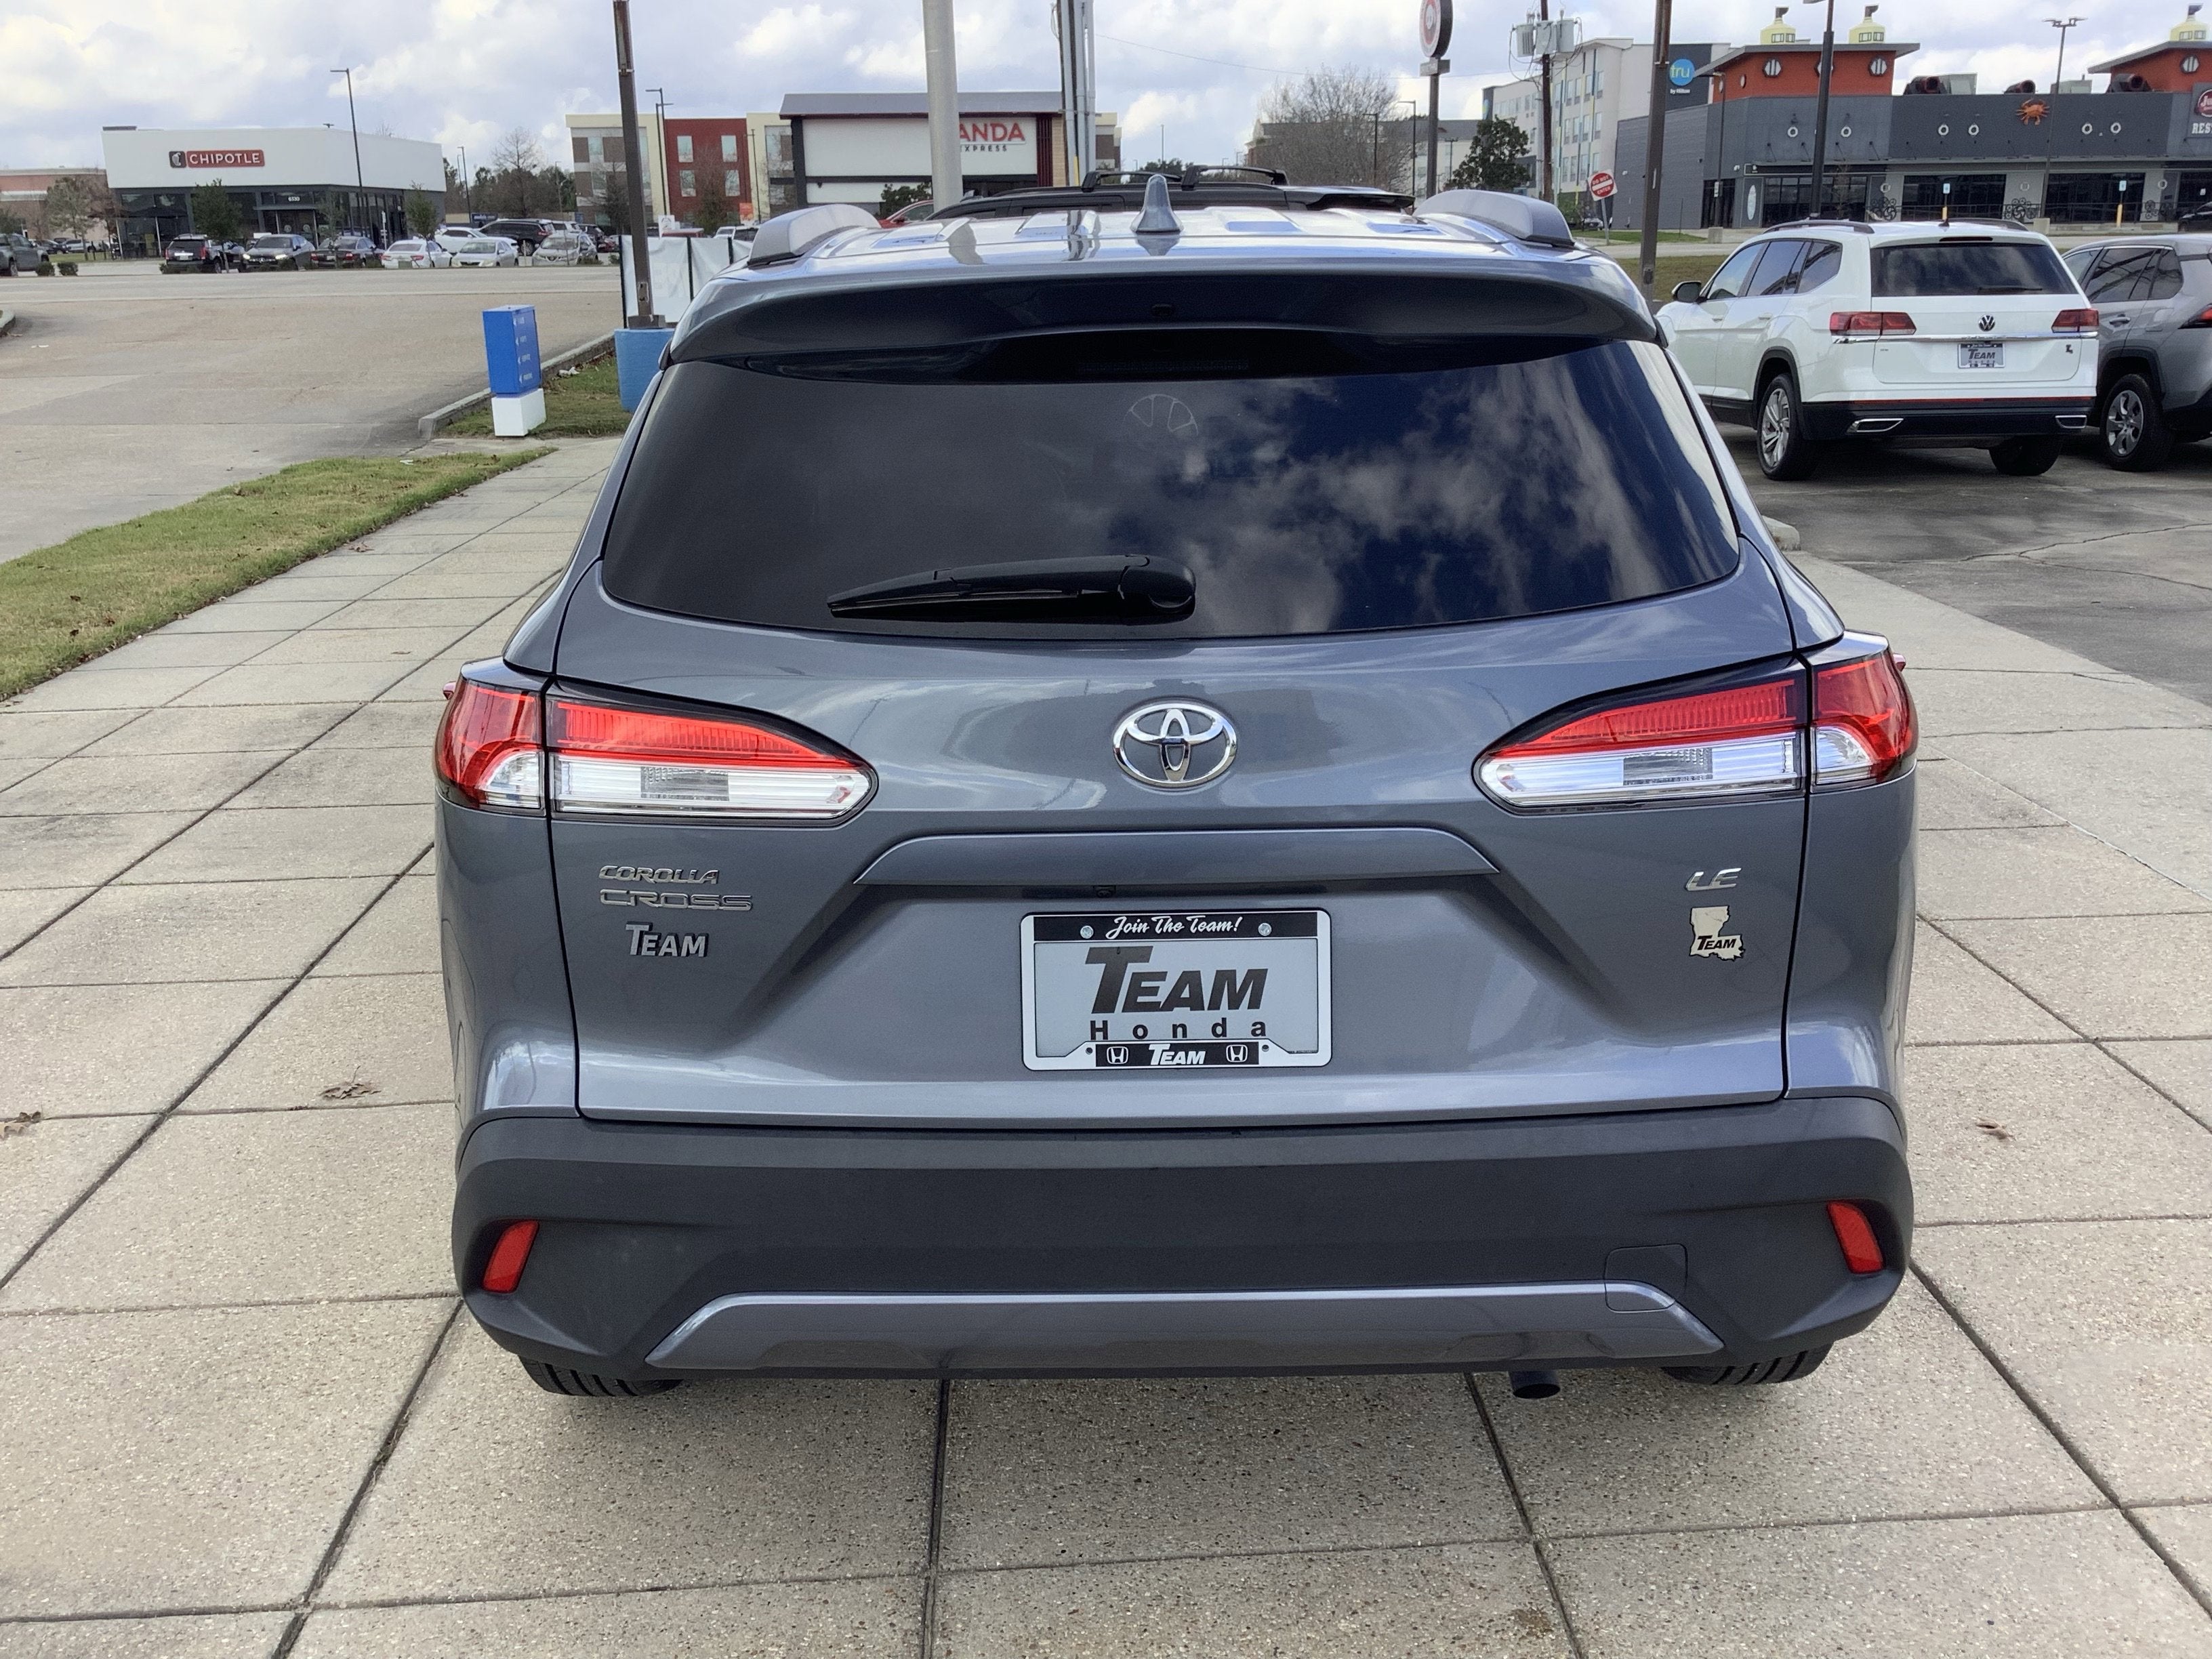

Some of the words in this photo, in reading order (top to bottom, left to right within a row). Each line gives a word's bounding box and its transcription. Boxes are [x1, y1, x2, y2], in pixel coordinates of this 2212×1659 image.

[960, 122, 1025, 142] ANDA
[2192, 123, 2212, 134] RES
[189, 152, 261, 164] CHIPOTLE
[1597, 186, 1611, 194] ENTER
[1968, 348, 1996, 360] TEAM
[598, 865, 719, 884] COROLLA
[1685, 867, 1742, 891] LE
[600, 888, 753, 912] CROSS
[1105, 916, 1150, 939] Join
[1151, 916, 1185, 934] The
[1186, 915, 1243, 933] Team!
[625, 921, 710, 958] TEAM
[1697, 935, 1737, 951] TEAM
[1085, 945, 1269, 1015] TEAM
[1090, 1017, 1267, 1041] Honda
[1148, 1043, 1206, 1066] TEAM
